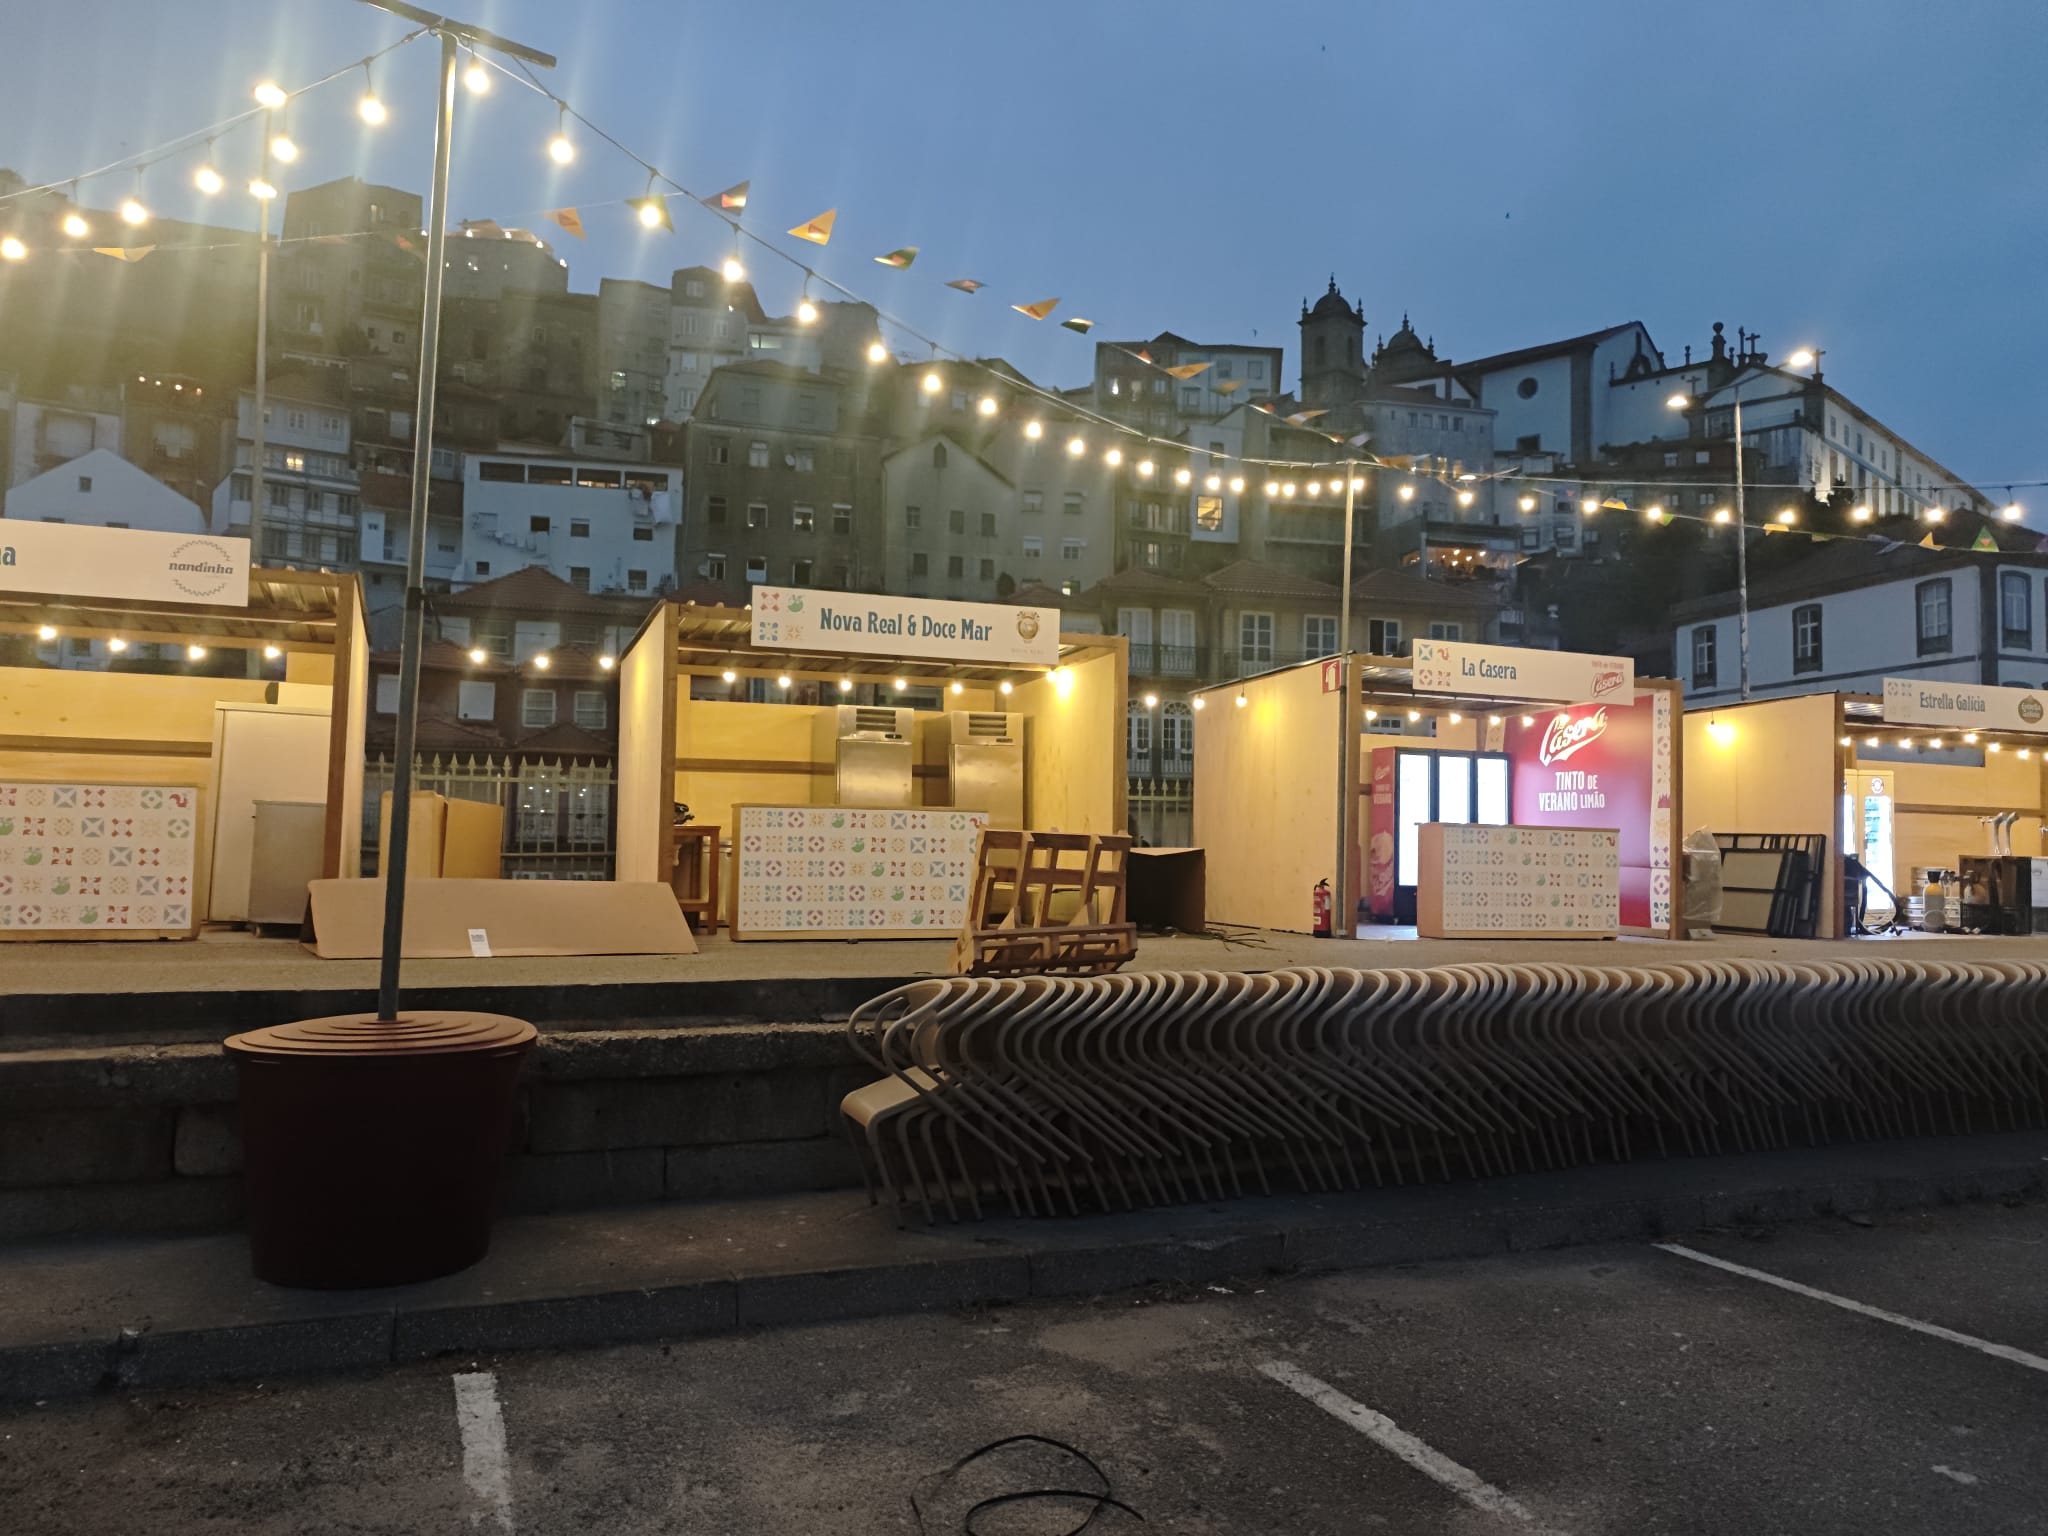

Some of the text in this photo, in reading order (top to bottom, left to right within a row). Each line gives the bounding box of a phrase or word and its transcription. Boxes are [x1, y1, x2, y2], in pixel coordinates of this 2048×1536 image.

[0, 546, 16, 566] a
[169, 562, 233, 574] nandinha
[820, 608, 993, 641] Nova Real & Doce Mar
[1462, 657, 1517, 680] La Casera
[1920, 692, 1985, 712] Estrella Galicia
[1540, 706, 1607, 767] Casera
[1555, 771, 1598, 791] TINTO DE
[1539, 791, 1605, 812] VERANO LIMÃO
